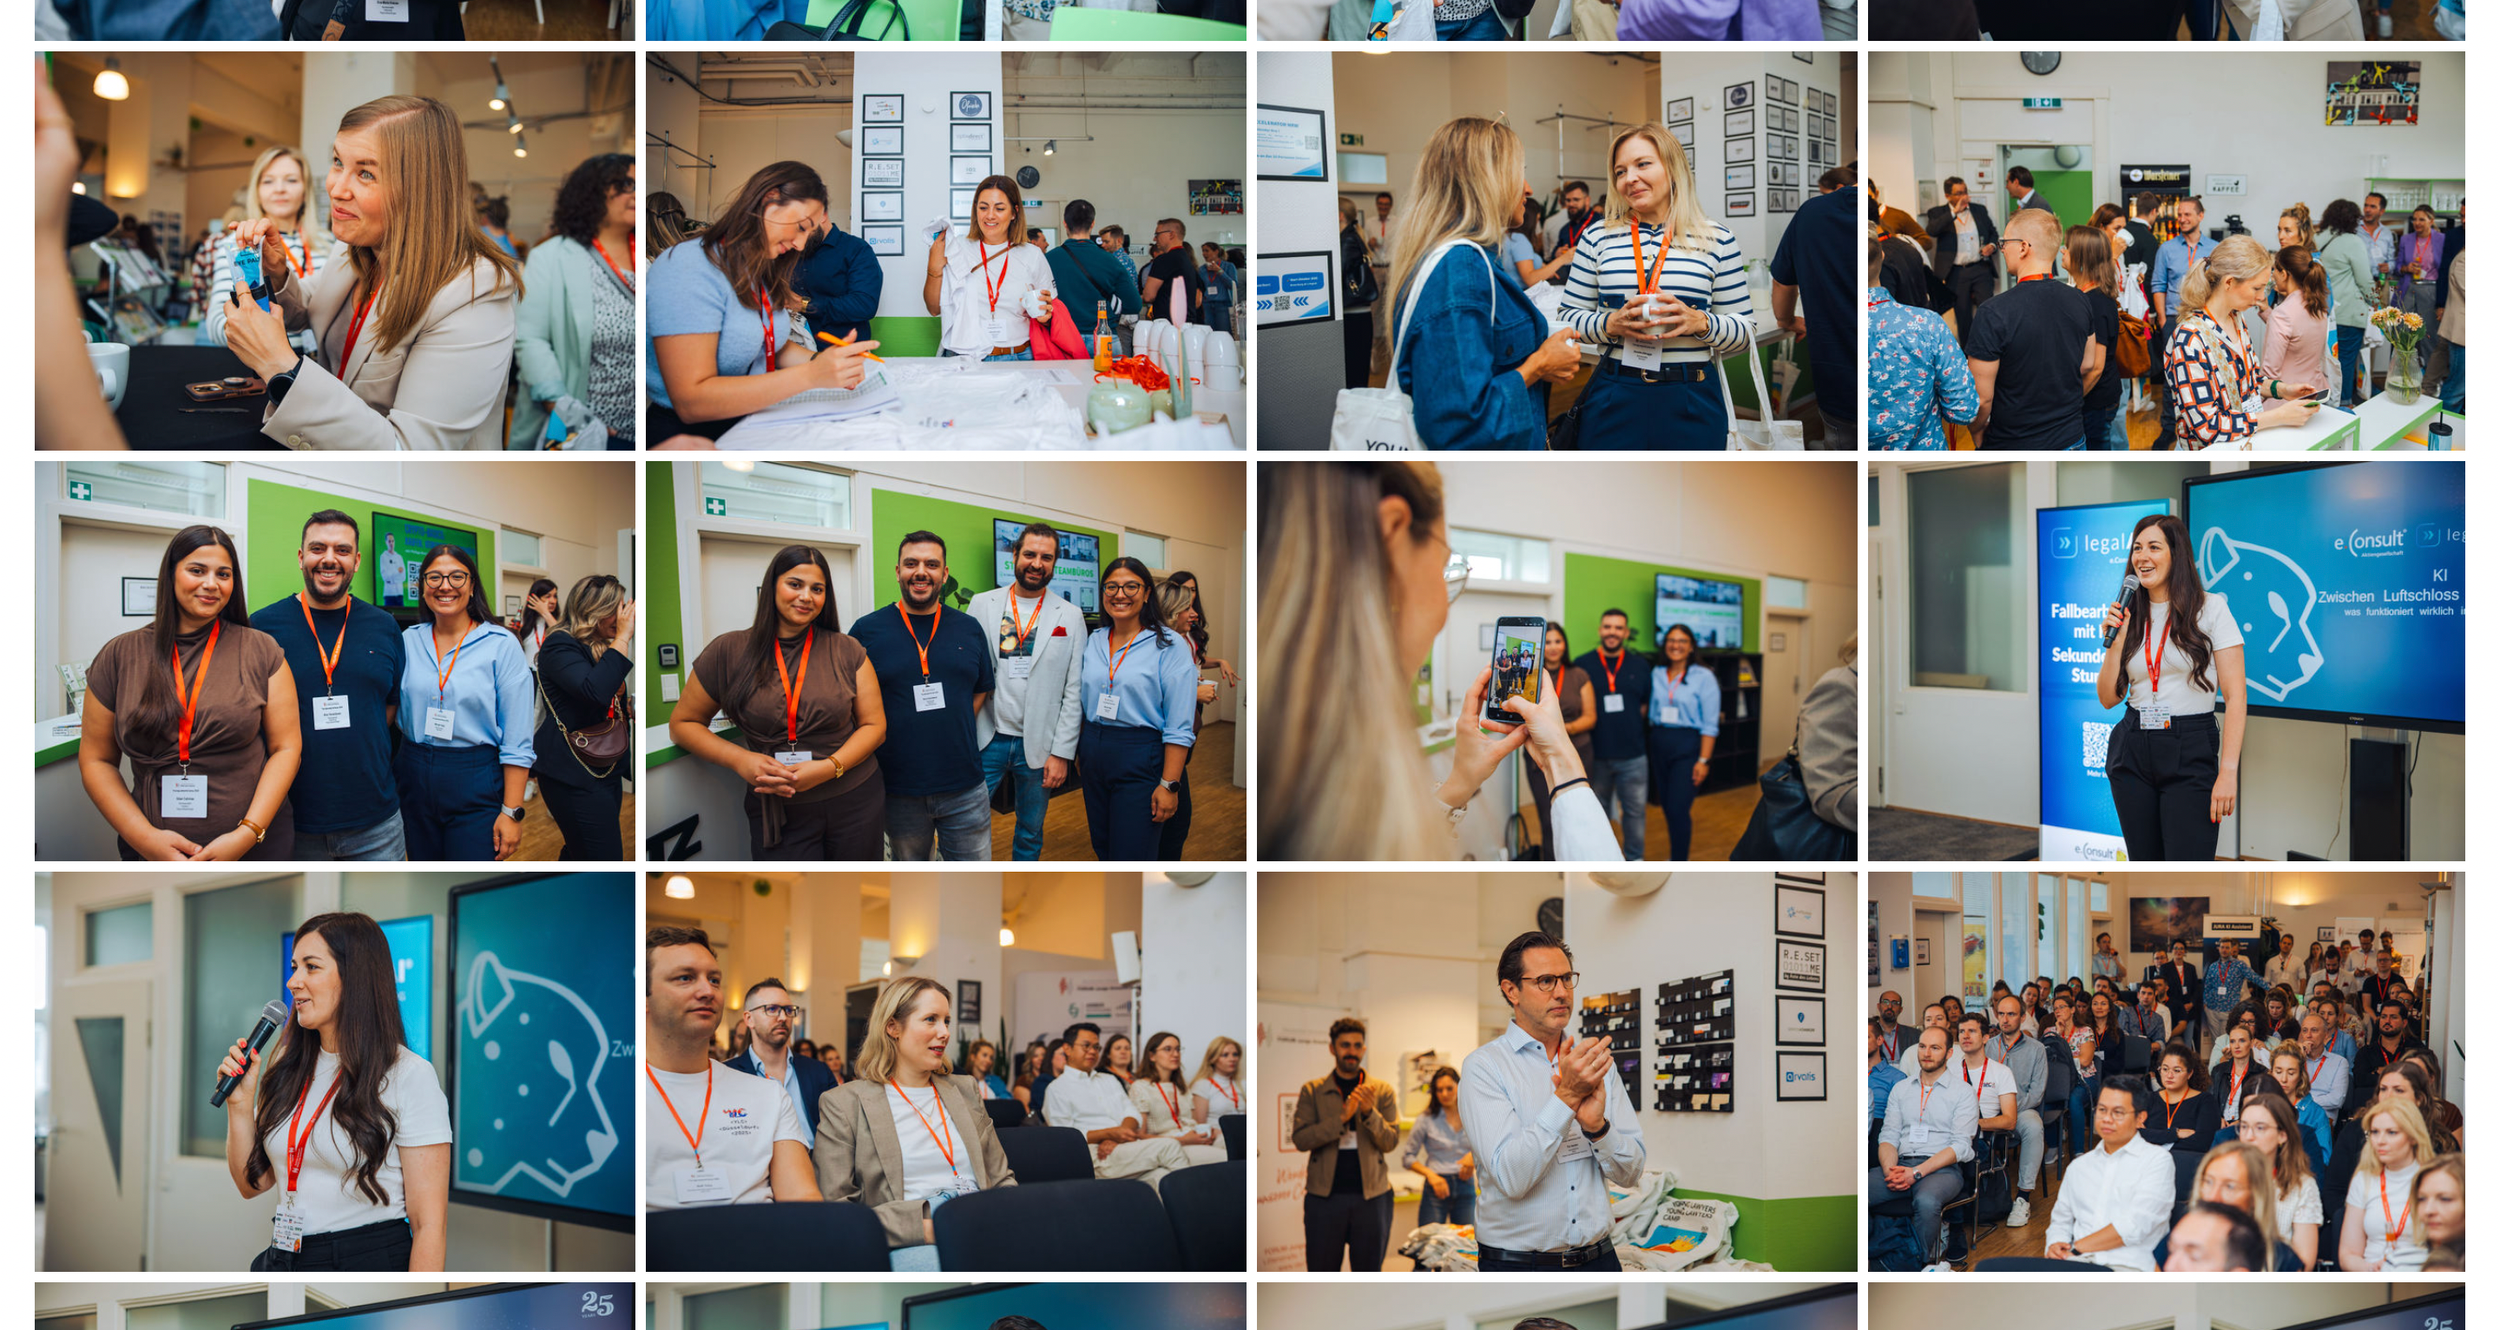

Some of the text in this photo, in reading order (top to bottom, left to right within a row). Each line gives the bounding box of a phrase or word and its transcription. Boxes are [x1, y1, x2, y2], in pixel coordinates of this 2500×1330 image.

[2361, 550, 2404, 558] Aktiengesellschaft
[1055, 565, 1094, 578] TEAMBÜROS
[2433, 569, 2448, 582] KI
[2318, 588, 2460, 603] Zwischen Luftschloss
[2344, 608, 2361, 617] was
[2366, 607, 2414, 617] funktioniert
[2419, 606, 2454, 616] wirklich
[2073, 624, 2096, 639] mit
[1783, 949, 1820, 962] R.E.SET
[1783, 961, 1820, 974] 01011ME
[581, 1291, 614, 1317] 25
